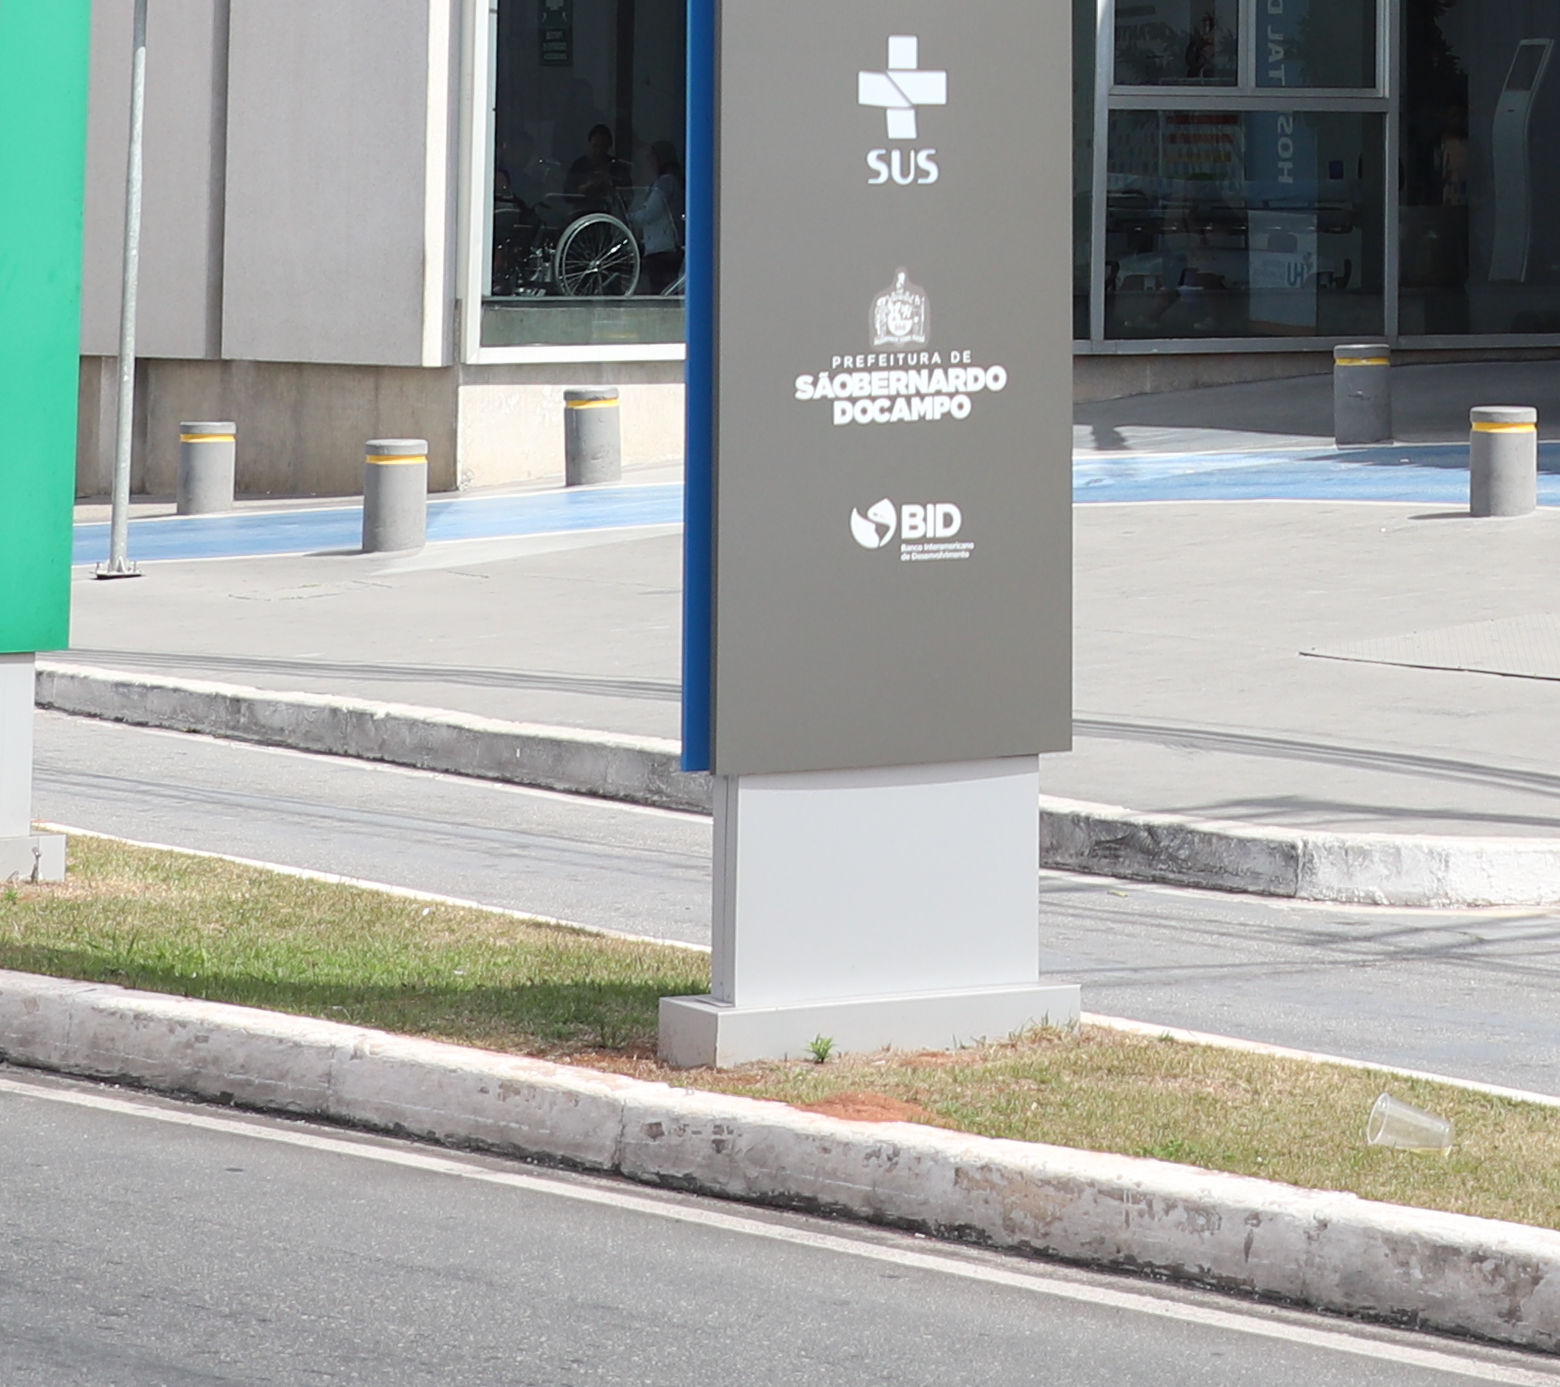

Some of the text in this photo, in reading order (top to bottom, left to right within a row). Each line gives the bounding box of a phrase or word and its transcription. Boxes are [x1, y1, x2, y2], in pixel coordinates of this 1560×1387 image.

[866, 148, 940, 186] SUS
[831, 350, 972, 370] PREFEITURA DE
[901, 502, 962, 540] BID
[900, 551, 970, 561] de Desenvolvimento
[901, 543, 923, 552] Banco
